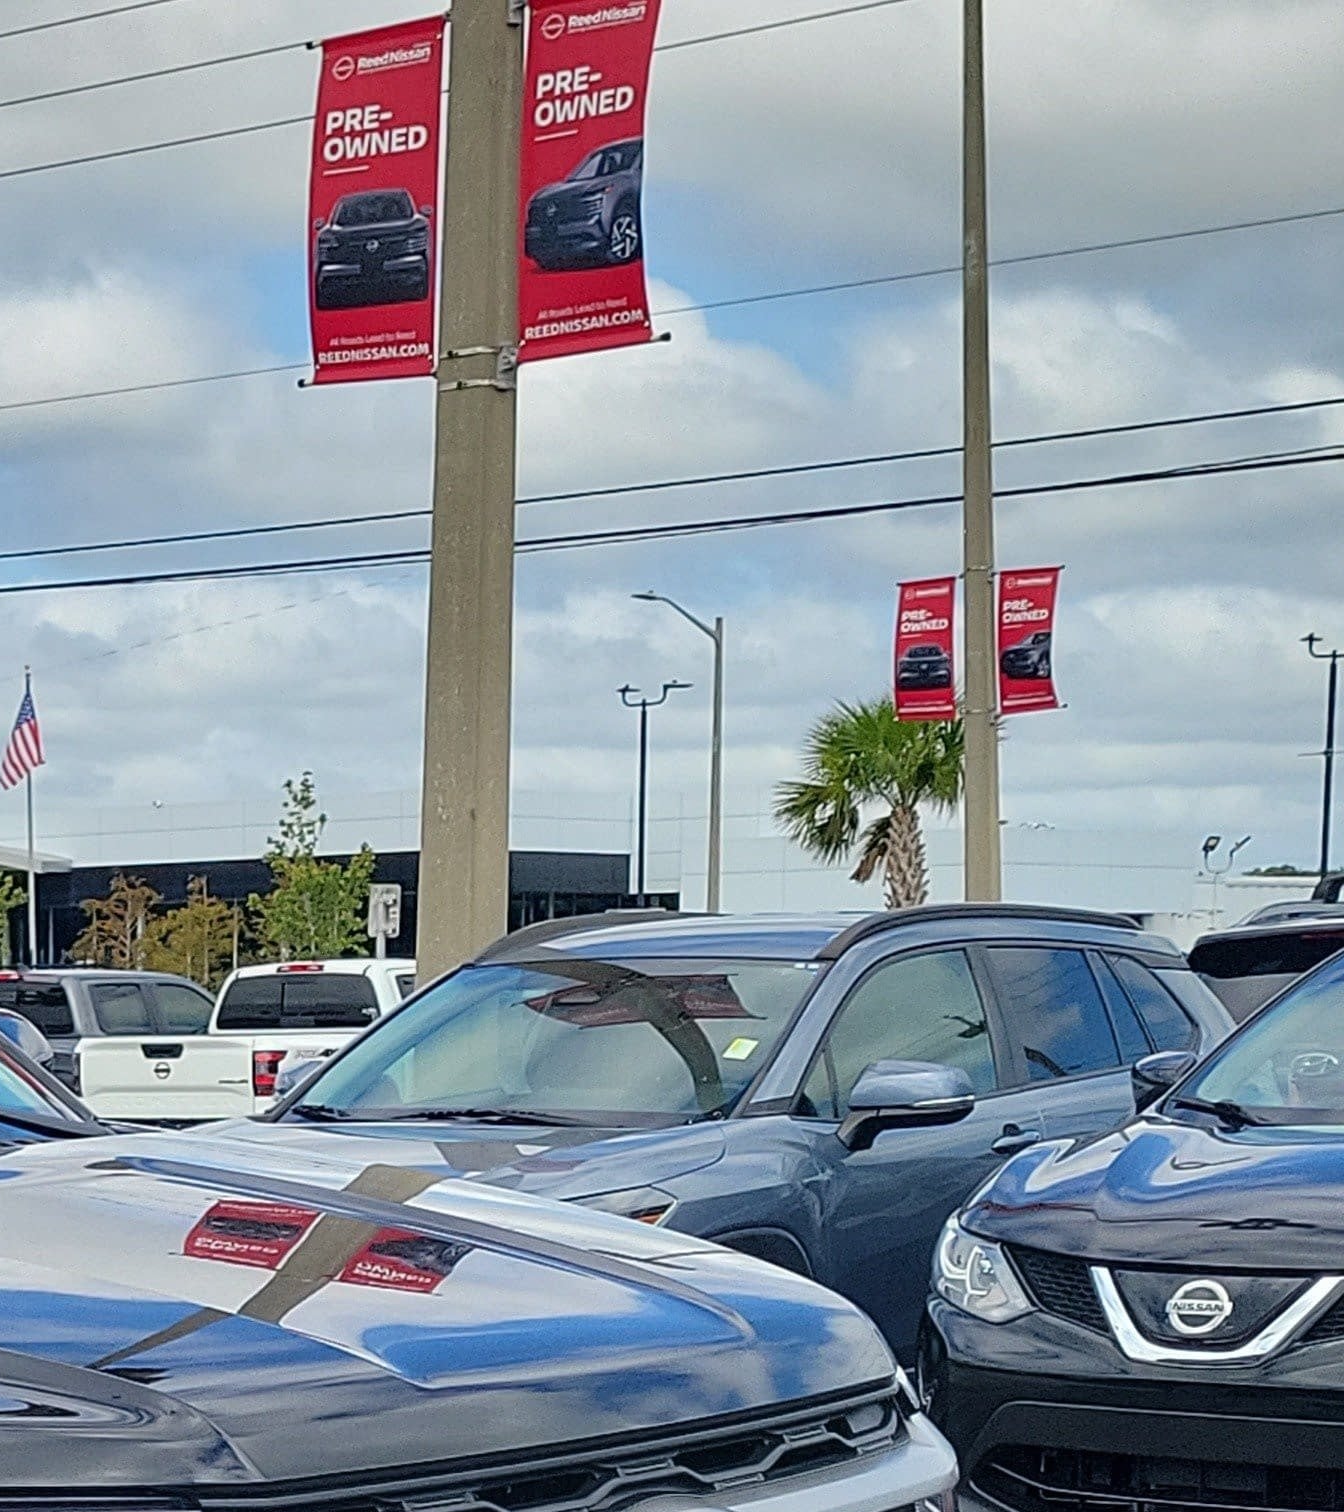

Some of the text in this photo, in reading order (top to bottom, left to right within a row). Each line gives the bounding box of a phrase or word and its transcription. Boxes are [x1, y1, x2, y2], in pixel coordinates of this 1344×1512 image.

[536, 65, 602, 99] PRE-
[326, 104, 393, 135] PRE-
[534, 86, 634, 127] OWNED
[323, 125, 428, 162] OWNED
[525, 308, 644, 339] REEDNISSAN.COM
[318, 343, 429, 364] REEDNISSAN.COM
[1172, 1302, 1224, 1312] NISSAN
